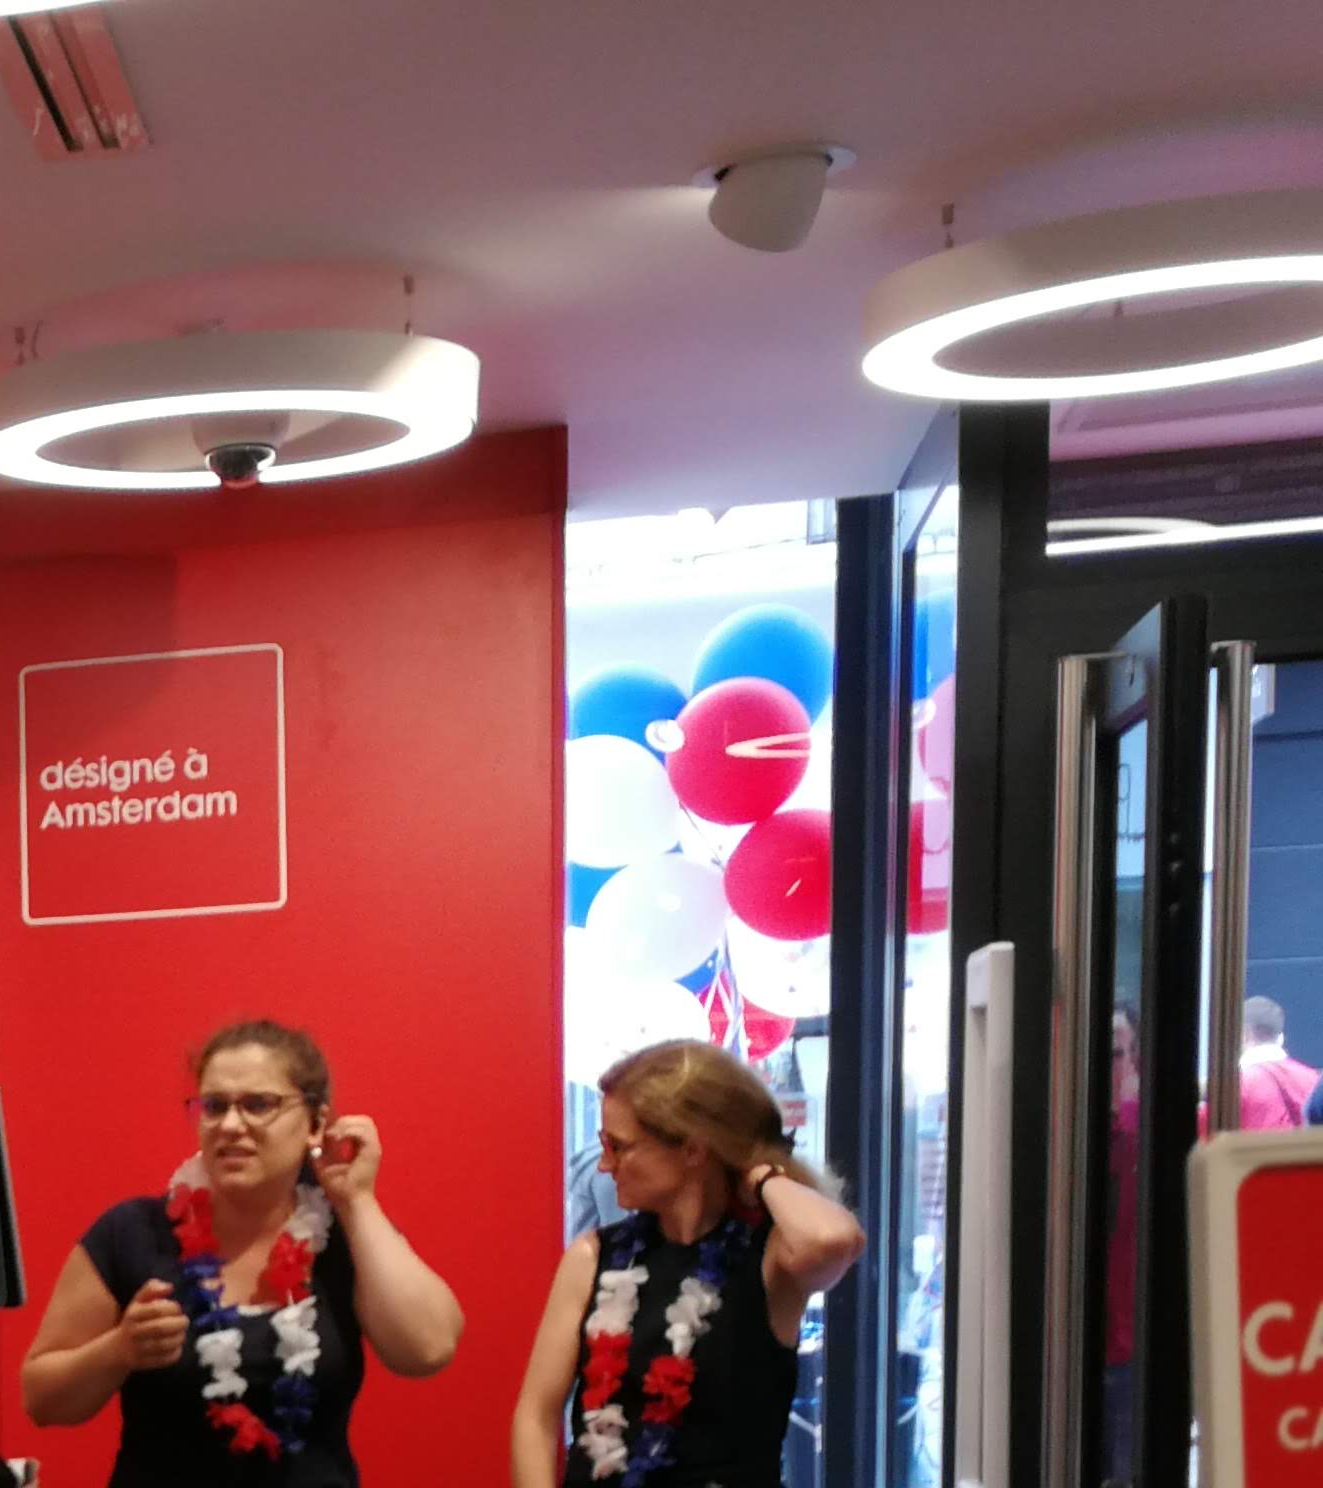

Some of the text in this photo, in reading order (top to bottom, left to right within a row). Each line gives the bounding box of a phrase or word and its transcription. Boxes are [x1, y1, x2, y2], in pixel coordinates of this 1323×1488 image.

[39, 746, 208, 793] désigné à
[39, 789, 238, 831] Amsterdam
